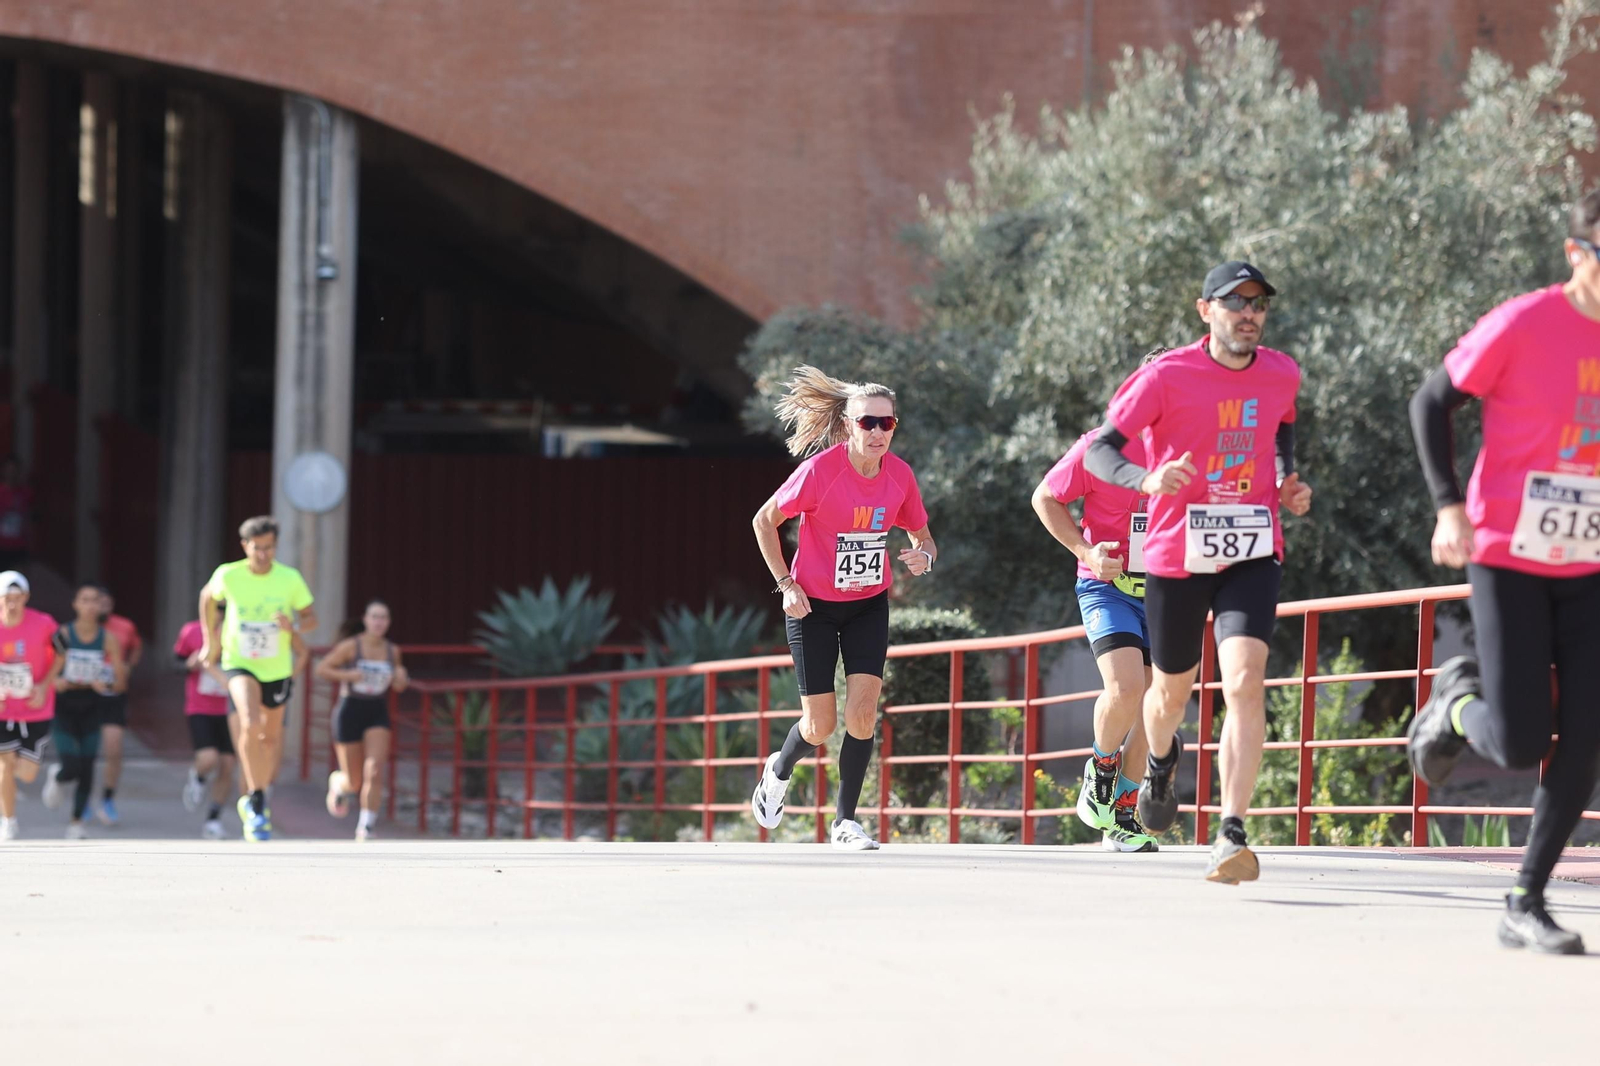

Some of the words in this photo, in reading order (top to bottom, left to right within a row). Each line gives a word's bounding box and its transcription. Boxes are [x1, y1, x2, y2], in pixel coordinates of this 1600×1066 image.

[1217, 398, 1258, 429] WE
[1221, 433, 1250, 450] RUN
[1206, 453, 1256, 481] UMA
[852, 506, 886, 530] WE
[1191, 517, 1230, 529] UMA
[1539, 506, 1600, 540] 618
[1203, 532, 1259, 558] 587
[838, 552, 881, 575] 454
